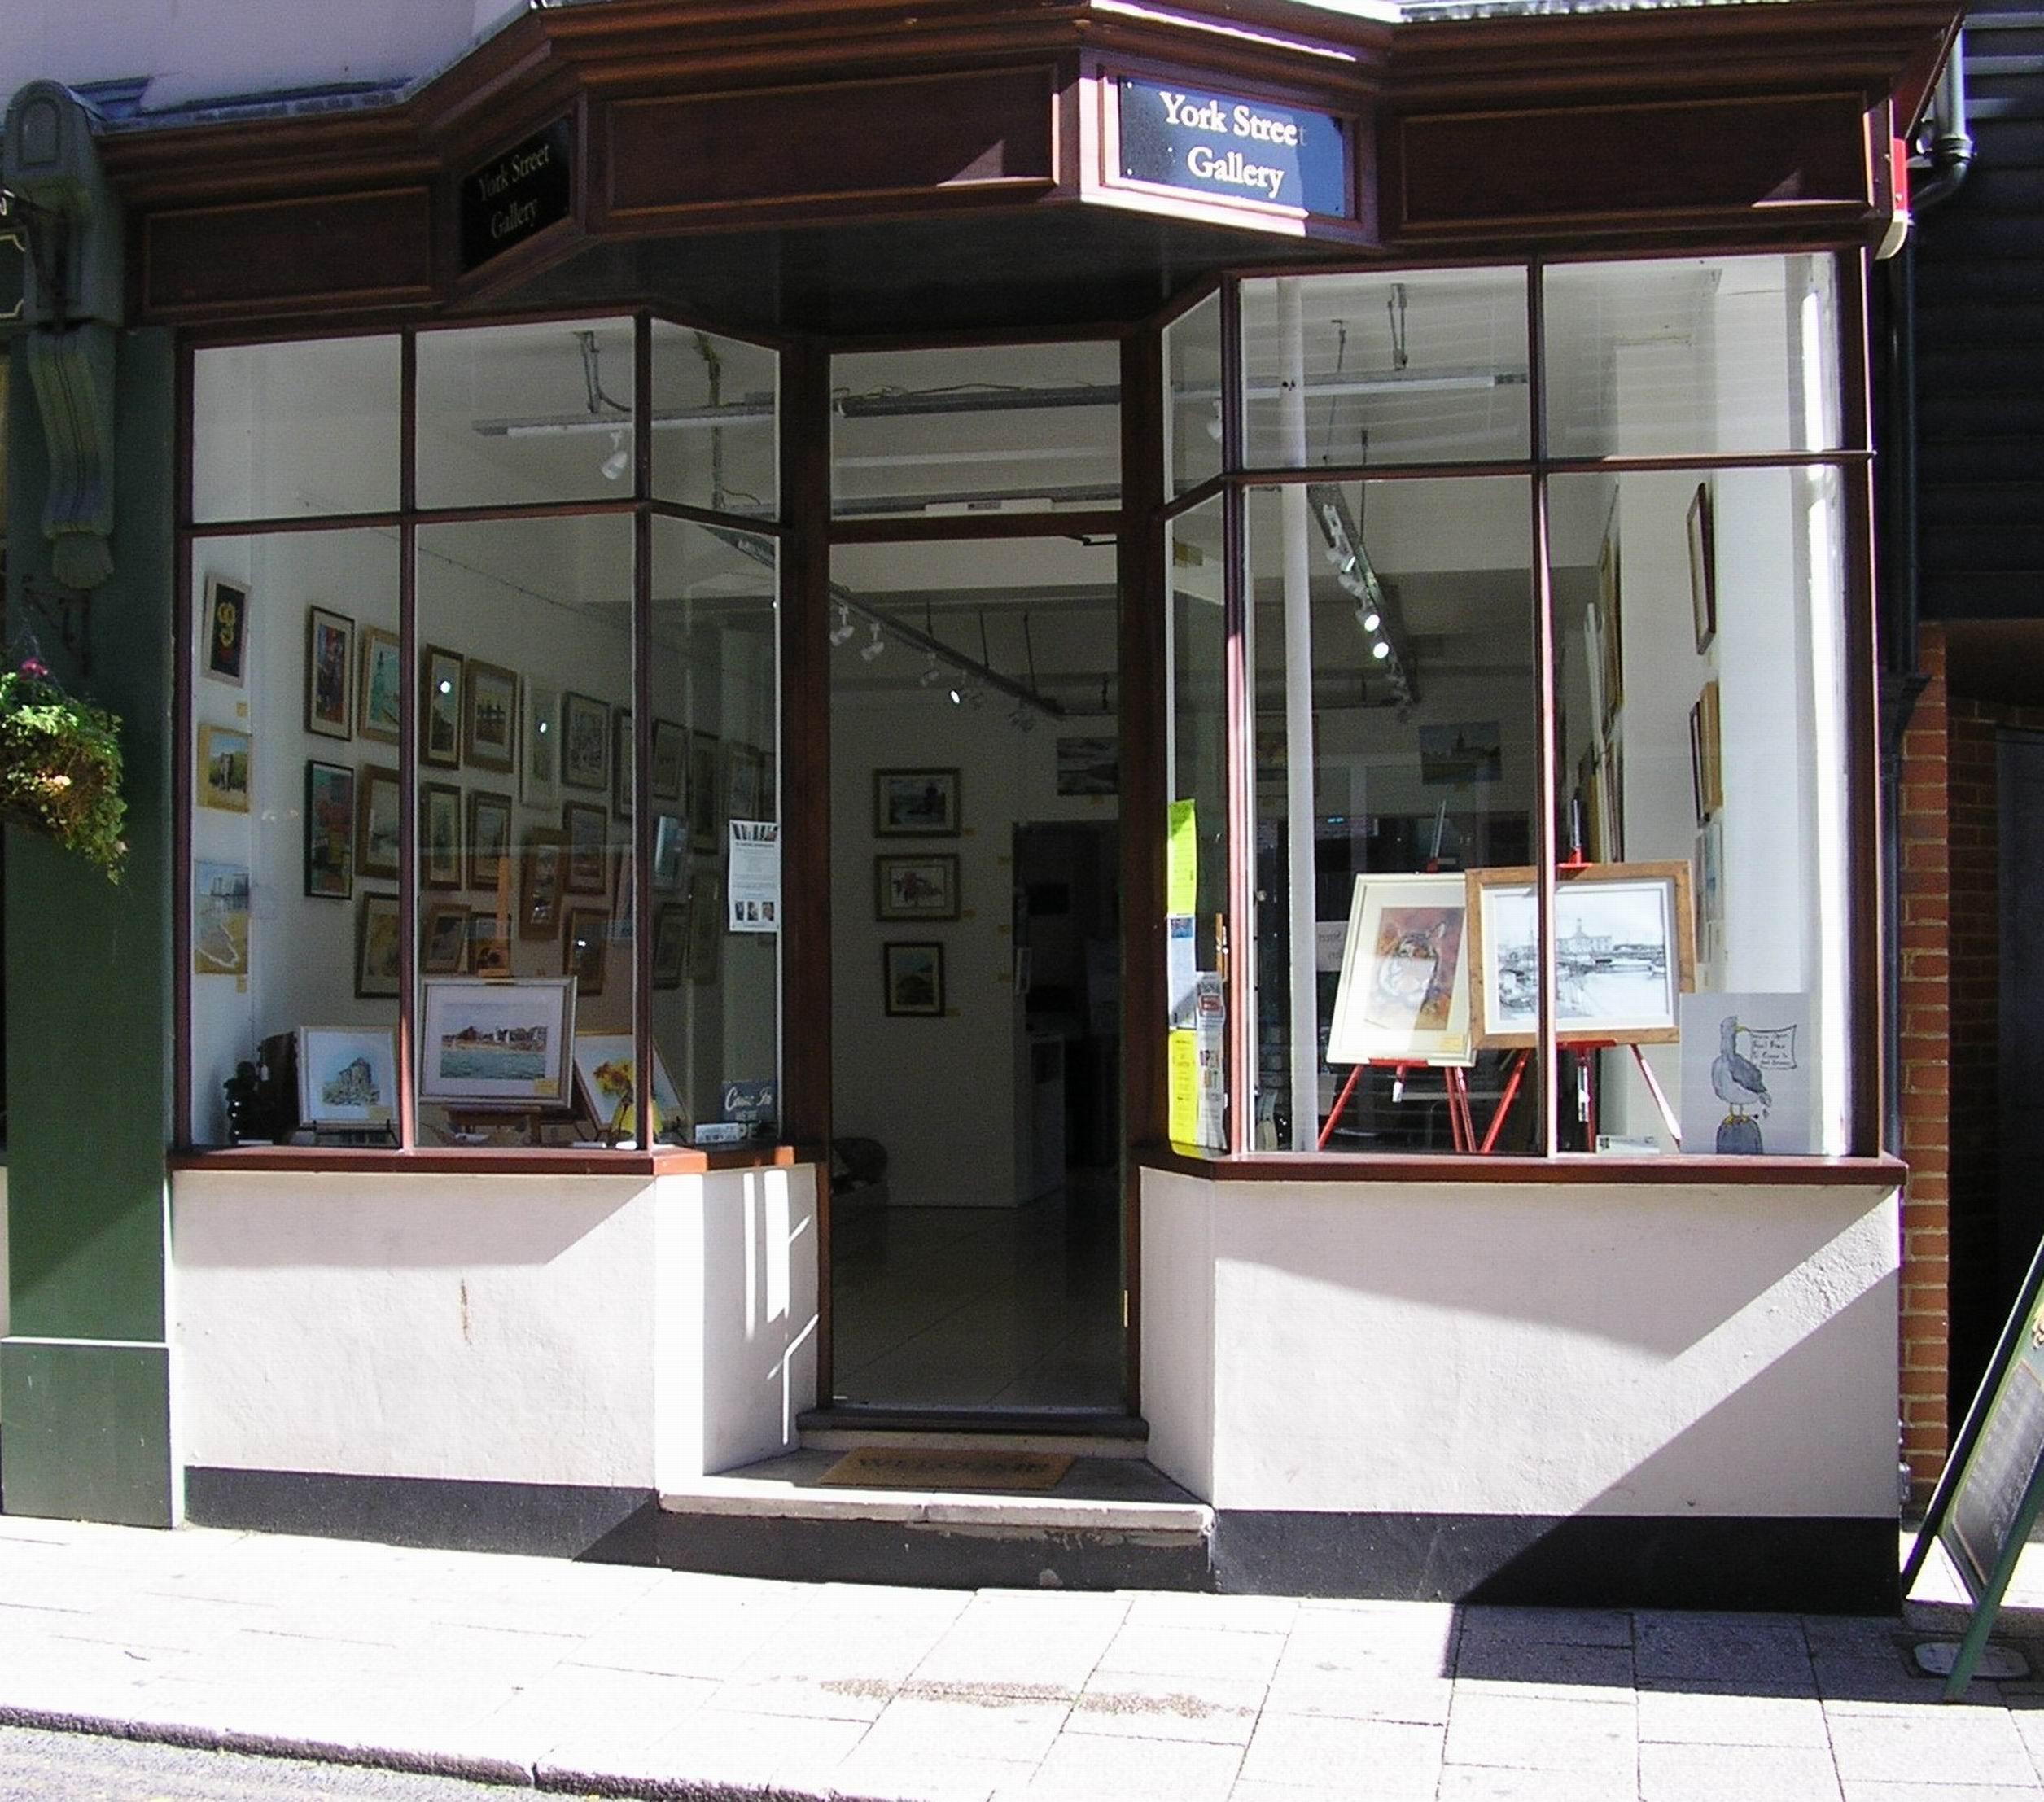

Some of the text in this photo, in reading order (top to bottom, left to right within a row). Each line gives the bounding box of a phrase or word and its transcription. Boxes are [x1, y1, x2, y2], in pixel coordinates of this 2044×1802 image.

[1159, 91, 1228, 133] York
[479, 144, 550, 202] York Street
[1187, 147, 1285, 198] Gallery
[491, 199, 538, 238] Gallery
